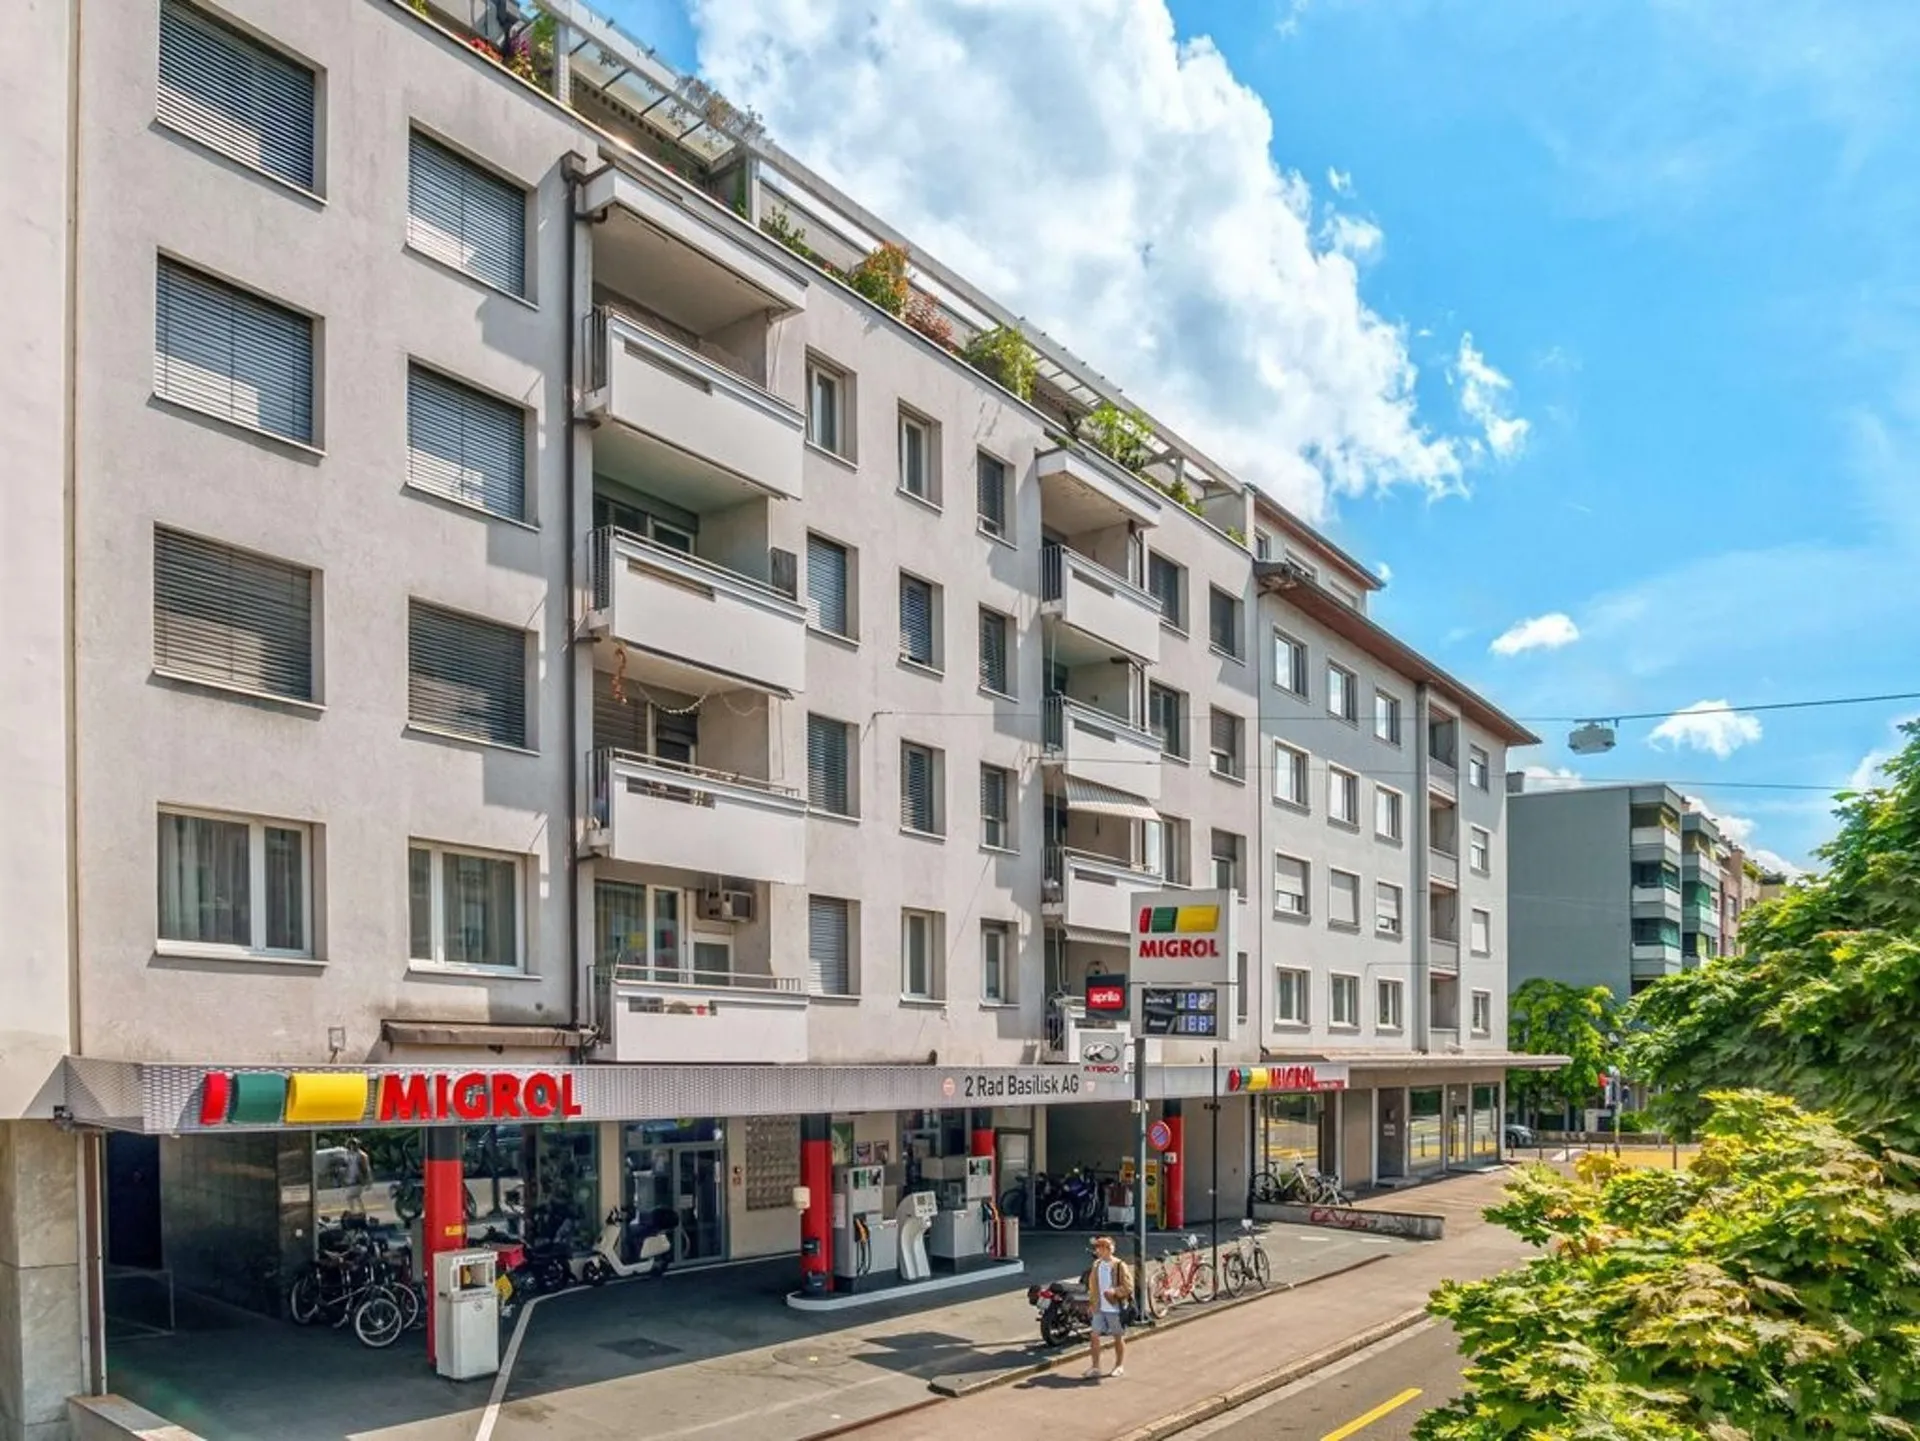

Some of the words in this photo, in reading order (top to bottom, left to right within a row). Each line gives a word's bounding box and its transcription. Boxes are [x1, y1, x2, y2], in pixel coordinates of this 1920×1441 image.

[1139, 938, 1219, 958] MIGROL
[379, 1072, 582, 1121] MIGROL
[964, 1075, 974, 1097] 2
[977, 1075, 1004, 1096] Rad
[1007, 1074, 1059, 1096] Basilisk
[1061, 1074, 1080, 1093] AG
